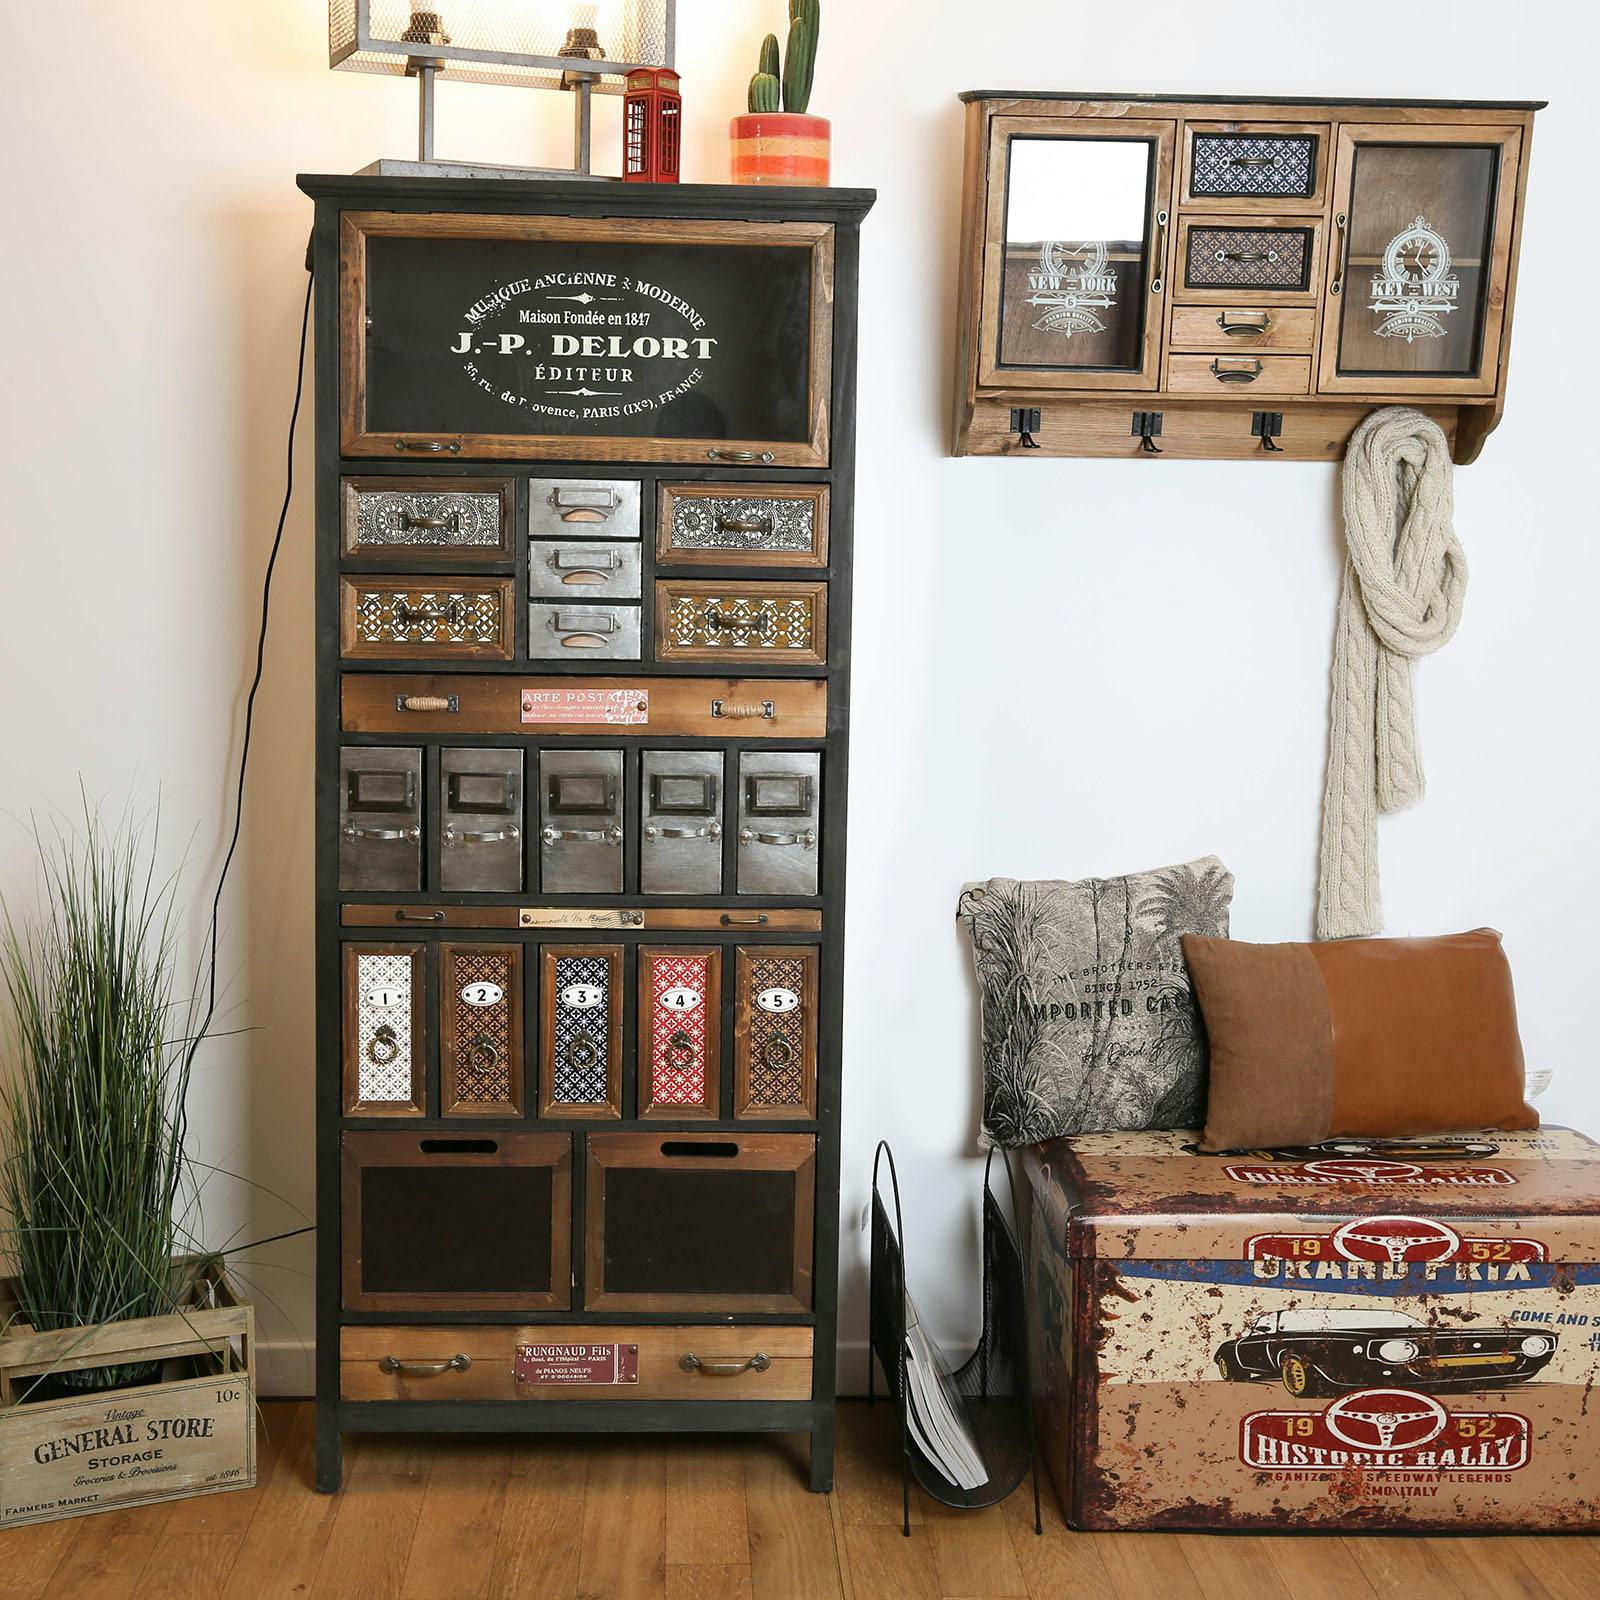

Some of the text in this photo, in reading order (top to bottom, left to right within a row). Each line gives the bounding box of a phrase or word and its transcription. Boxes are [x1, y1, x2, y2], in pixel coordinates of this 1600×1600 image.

[1028, 275, 1118, 291] NEW YORK
[1372, 281, 1460, 296] KEY WEST
[534, 272, 617, 289] ANCIENNE
[635, 280, 706, 331] MODERNE
[519, 310, 651, 327] Maison Fondée en 1847
[450, 332, 718, 359] J.-P. DELORT
[534, 363, 633, 382] ÉDITEUR
[501, 391, 516, 404] de
[582, 405, 620, 419] PARIS
[659, 368, 704, 405] FRANCE
[1083, 962, 1152, 976] BROTHERS
[1085, 979, 1157, 993] SINCE 1752
[383, 993, 388, 1005] 1
[477, 988, 486, 1001] 2
[578, 990, 586, 1003] 3
[675, 994, 685, 1007] 4
[773, 995, 782, 1007] 5
[1289, 1239, 1320, 1255] 19
[1472, 1243, 1511, 1259] 52
[1510, 1310, 1553, 1323] COME
[1556, 1313, 1588, 1326] AND
[592, 1347, 612, 1356] Fils
[104, 1408, 146, 1421] Vintage
[1284, 1418, 1313, 1437] 19
[1460, 1419, 1496, 1438] 52
[34, 1418, 215, 1465] GENERAL STORE
[1257, 1433, 1515, 1466] HISTORIC RALLY
[88, 1449, 163, 1470] STORAGE
[73, 1473, 115, 1487] Groceries
[128, 1464, 178, 1479] Provisions
[1367, 1473, 1442, 1483] SPEEDWAY
[1449, 1473, 1513, 1483] LEGENDS
[5, 1494, 99, 1516] FARMERS MARKET
